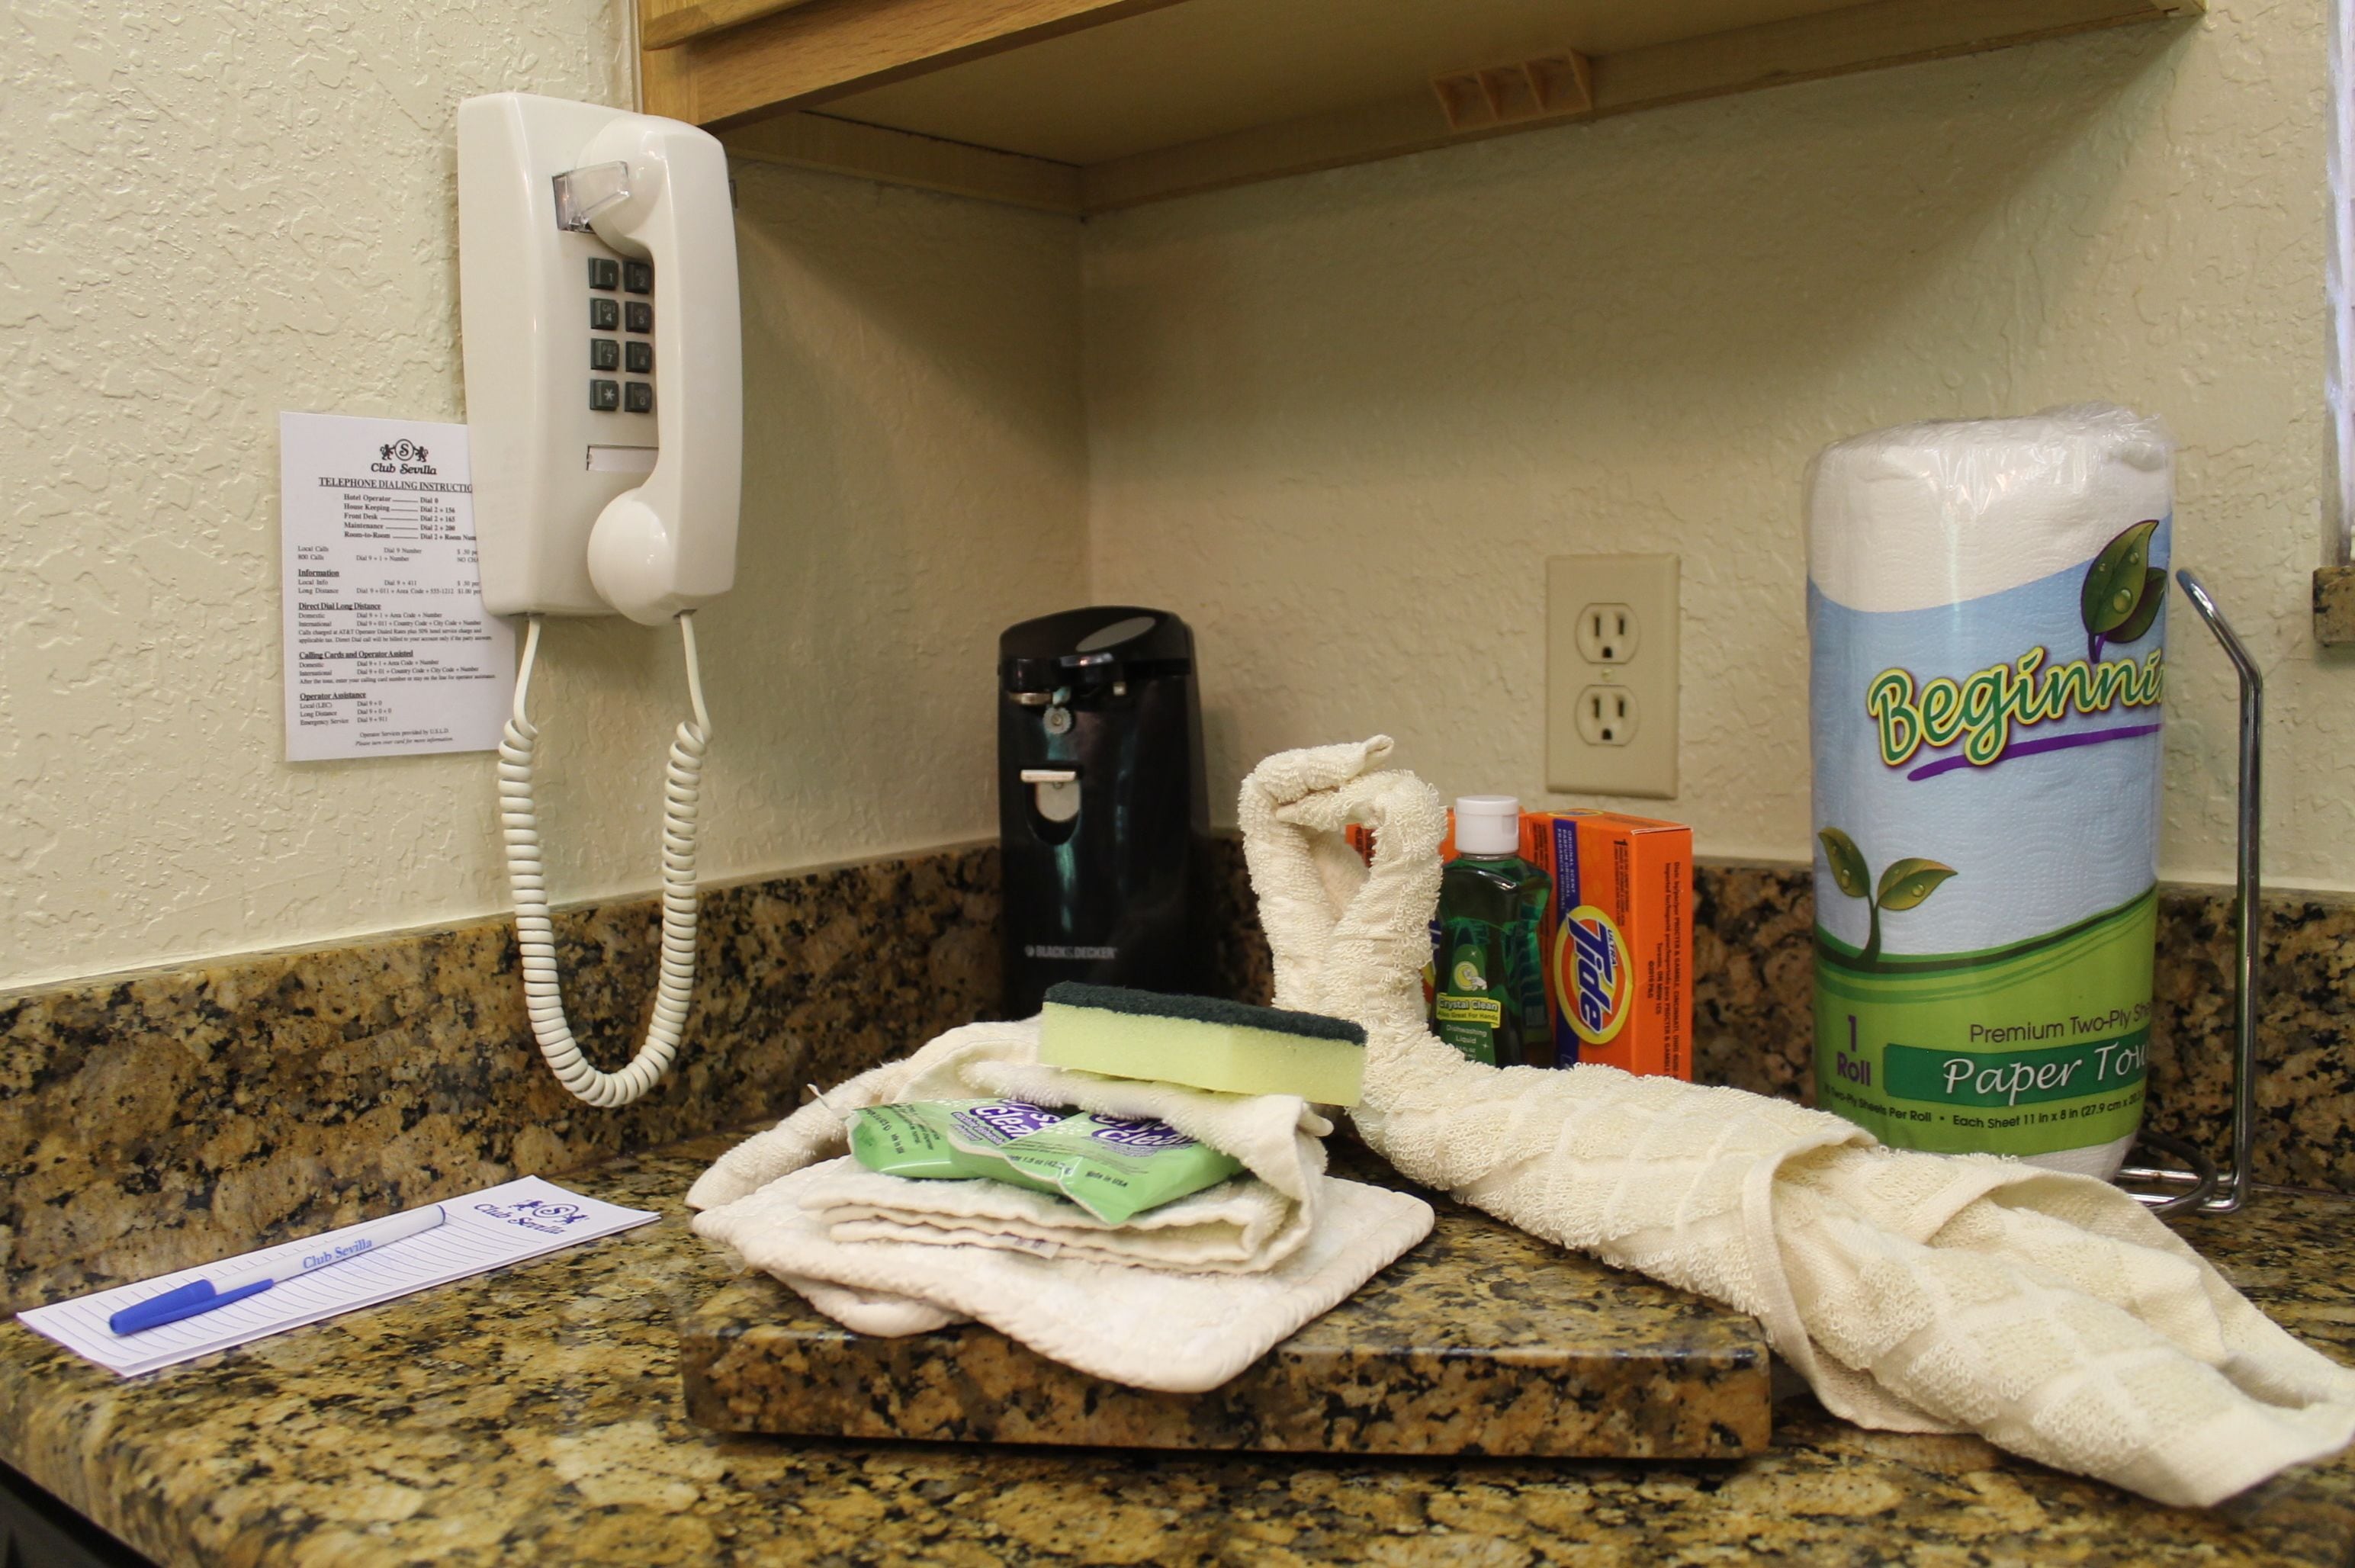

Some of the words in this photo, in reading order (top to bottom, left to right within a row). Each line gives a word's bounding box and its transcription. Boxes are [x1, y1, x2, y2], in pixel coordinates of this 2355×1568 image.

[370, 462, 396, 474] Club
[399, 464, 437, 476] Sevilla
[318, 477, 377, 489] TELEPHONE
[378, 480, 417, 490] DIALING
[343, 503, 363, 511] House
[364, 503, 390, 512] Keeping
[297, 569, 339, 577] Information
[298, 602, 320, 611] Direct
[320, 602, 335, 611] Dial
[336, 602, 353, 611] Long
[353, 602, 381, 611] Distance
[298, 651, 323, 660] Calling
[324, 651, 345, 660] Cards
[345, 651, 357, 659] and
[358, 650, 388, 659] Operator
[388, 650, 413, 658] Assisted
[300, 692, 332, 701] Operator
[333, 691, 366, 700] Assistance
[1608, 929, 1618, 967] ULTRA
[1567, 914, 1614, 1034] Tide
[1439, 998, 1470, 1011] Crystal
[1471, 1000, 1499, 1012] Clean
[1446, 1024, 1488, 1038] Dishwashing
[1970, 1021, 2064, 1043] Premium
[2070, 1008, 2132, 1035] Two-Ply
[1456, 1035, 1477, 1044] Liquid
[1848, 1014, 1857, 1052] 1
[1836, 1050, 1871, 1087] Roll
[1942, 1058, 2084, 1107] Paper
[1859, 1098, 1887, 1117] Sheets
[1889, 1107, 1907, 1120] Per
[1910, 1110, 1932, 1123] Roll
[1952, 1115, 1984, 1128] Each
[1987, 1116, 2020, 1129] Sheet
[2023, 1113, 2035, 1125] 11
[2039, 1111, 2048, 1123] in
[2051, 1113, 2058, 1121] x
[2060, 1109, 2067, 1120] 8
[2069, 1108, 2078, 1119] in
[2081, 1103, 2106, 1117] (27.9
[2107, 1103, 2121, 1112] cm
[1112, 1177, 1129, 1187] USA
[474, 1203, 513, 1219] Club
[507, 1216, 566, 1235] Sevilla
[303, 1252, 333, 1269] Club
[335, 1239, 373, 1258] Sevilla
